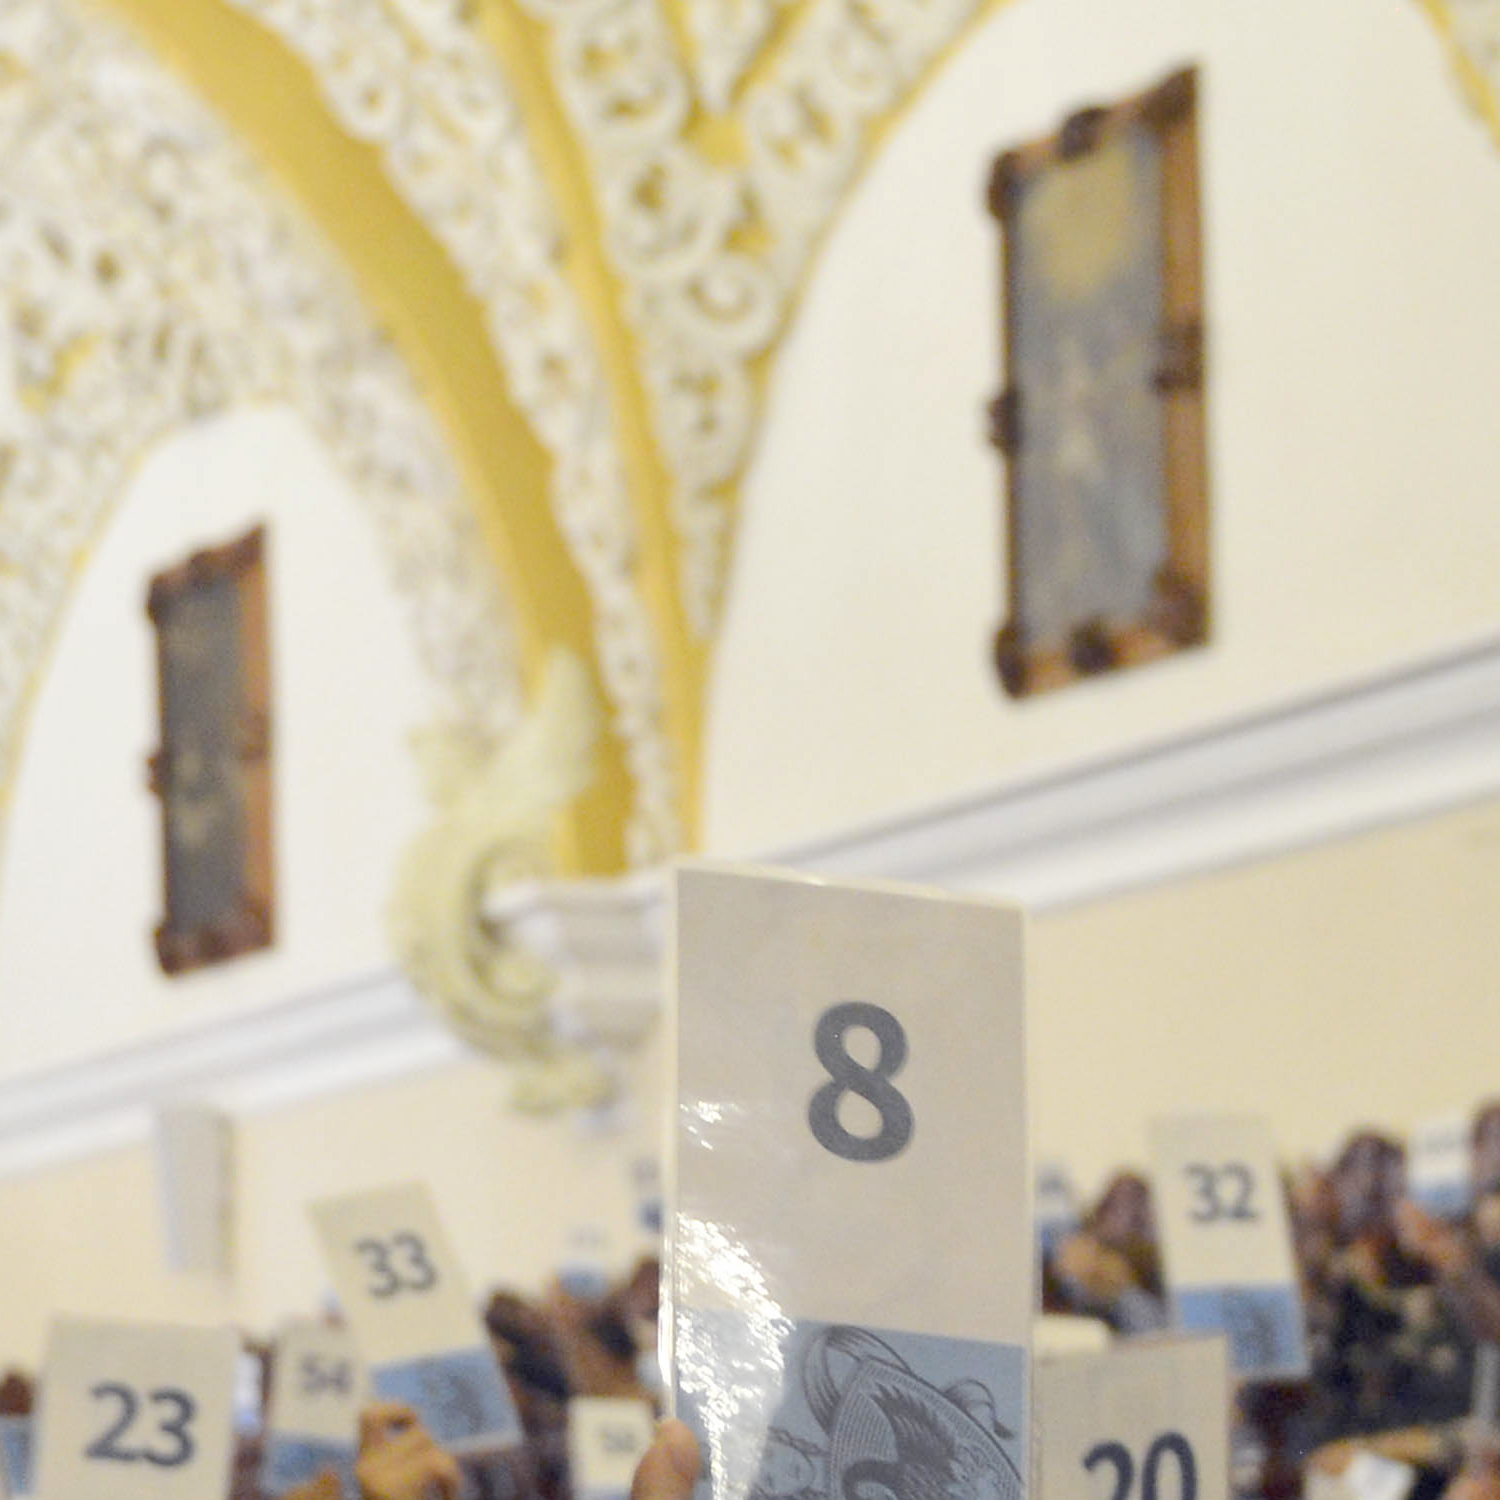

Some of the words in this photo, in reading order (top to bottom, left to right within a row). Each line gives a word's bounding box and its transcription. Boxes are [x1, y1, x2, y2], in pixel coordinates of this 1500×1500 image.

[808, 1002, 914, 1162] 8
[1185, 1163, 1259, 1225] 32
[354, 1232, 438, 1300] 33
[86, 1383, 196, 1469] 23
